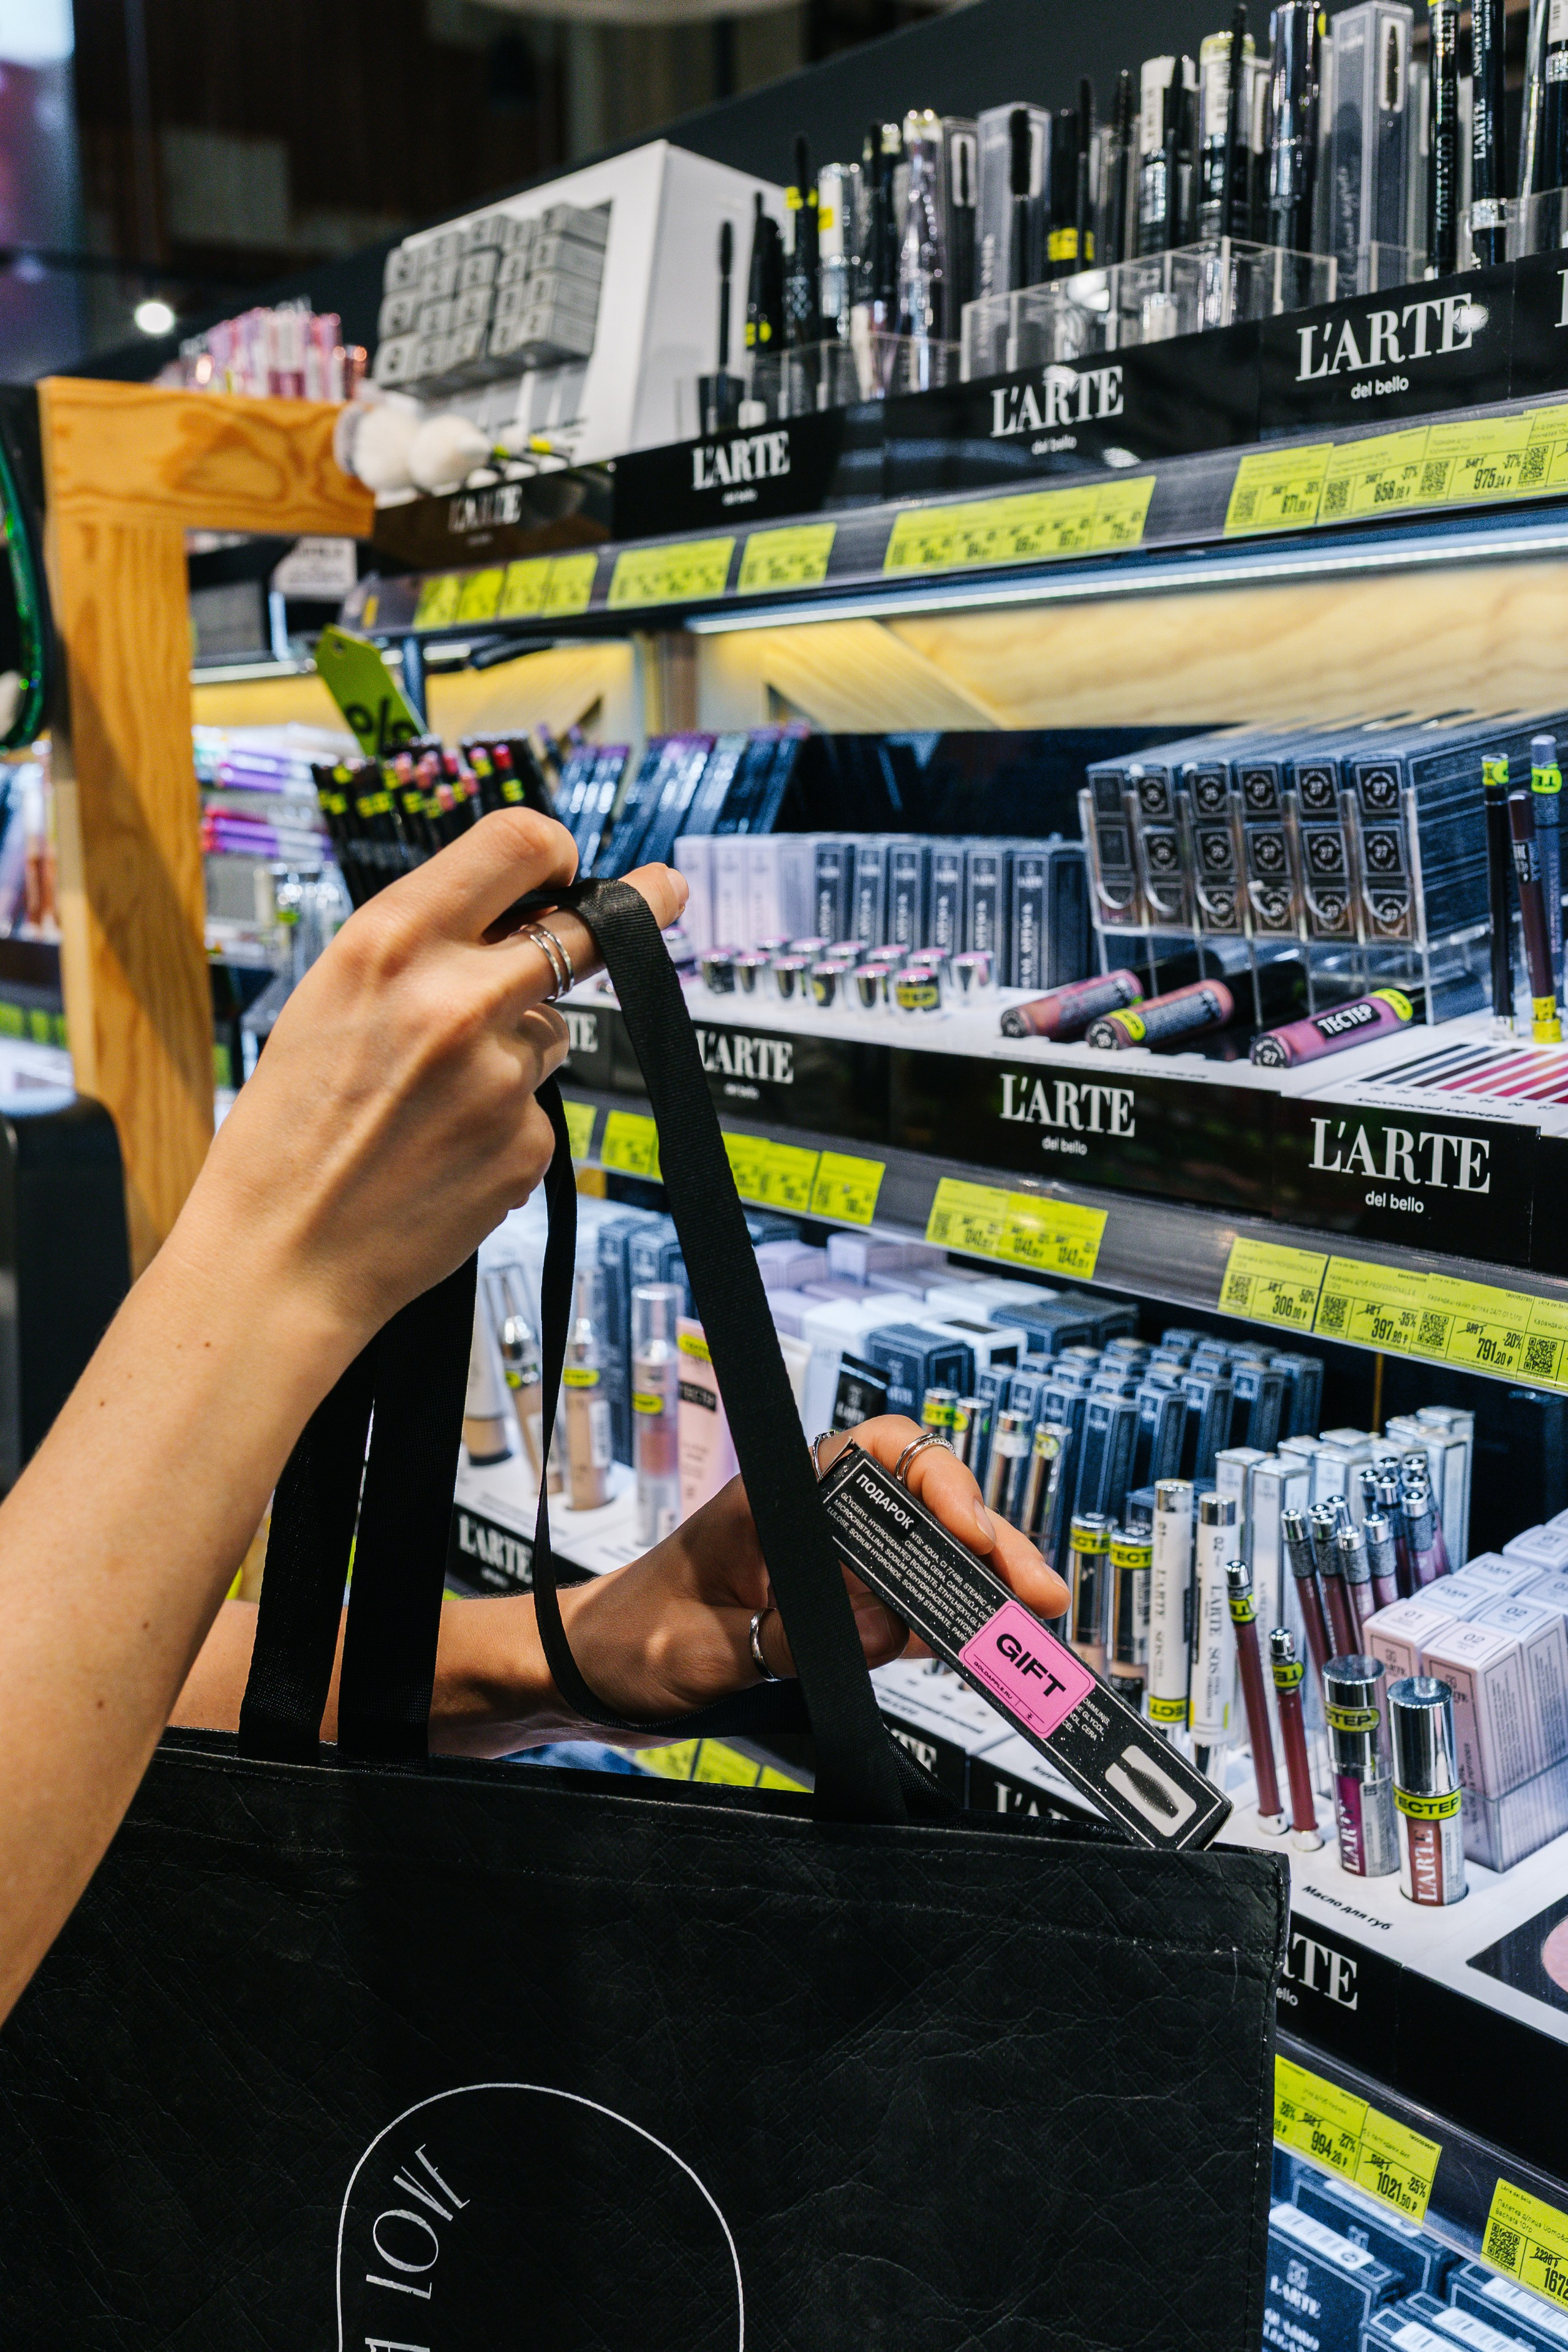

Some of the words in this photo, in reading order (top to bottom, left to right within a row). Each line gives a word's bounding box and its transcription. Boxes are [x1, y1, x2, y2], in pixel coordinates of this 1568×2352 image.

[1295, 293, 1471, 382] L'ARTE
[990, 366, 1123, 438] L'ARTE
[1351, 380, 1372, 400] del
[1375, 375, 1409, 395] bello
[691, 430, 791, 491] L'ARTE
[1309, 781, 1323, 796] 27
[1373, 782, 1388, 796] 27
[1374, 845, 1389, 859] 27
[1317, 1004, 1372, 1035] ТЕСТЕР
[695, 1029, 794, 1084] L'ARTE
[1263, 1049, 1278, 1065] 27
[1000, 1074, 1136, 1137] L'ARTE
[1042, 1136, 1058, 1150] del
[1060, 1138, 1087, 1155] bello
[1309, 1118, 1490, 1193] L'ARTE
[1365, 1190, 1386, 1207] del
[1390, 1196, 1424, 1213] bello
[1398, 1311, 1417, 1328] -35%
[1503, 1332, 1523, 1350] -20%
[855, 1473, 915, 1531] ПОДАРОК
[459, 1514, 533, 1584] L'ARTE
[1213, 1536, 1224, 1551] 02
[832, 1499, 886, 1551] MICROCRISTALLINA,
[884, 1548, 907, 1571] SODIUM
[905, 1569, 956, 1619] DEHYDROACETATE,
[955, 1616, 976, 1637] HYDRO
[840, 1492, 869, 1521] GLYCERYL
[867, 1518, 911, 1561] HYDROGENATED
[909, 1559, 939, 1588] ROSINATE,
[937, 1586, 982, 1630] ETHYLHEXYLGLY
[826, 1507, 850, 1530] LULOSE,
[848, 1528, 872, 1550] SODIUM
[869, 1548, 903, 1581] HYDROXIDE,
[901, 1578, 924, 1601] SODIUM
[922, 1599, 953, 1629] STEARATE,
[951, 1626, 969, 1645] PARFU
[903, 1539, 931, 1567] CERIFERA
[946, 1580, 979, 1613] CANDELILLA
[921, 1544, 941, 1563] AQUA,
[945, 1566, 965, 1585] 77499,
[962, 1582, 987, 1606] STEARIC
[985, 1604, 997, 1616] AC
[1210, 1584, 1223, 1636] L'ARTE
[1404, 1610, 1424, 1621] 01
[1506, 1606, 1528, 1618] 02
[1463, 1632, 1485, 1645] 02
[973, 1660, 1012, 1700] GOLDAPPLE.RU
[996, 1634, 1066, 1699] GIFT
[1081, 1710, 1107, 1735] GLYCOL,
[1082, 1697, 1111, 1725] OMMUNIS,
[1080, 1724, 1098, 1741] CERA
[1415, 1829, 1438, 1902] L'ARTE
[1302, 1885, 1343, 1907] Масло
[1340, 1905, 1367, 1920] для
[1368, 1917, 1394, 1930] губ
[1276, 1986, 1298, 2007] ello
[1339, 2133, 1356, 2153] -27%
[1408, 2176, 1428, 2198] -25%
[1495, 2207, 1518, 2225] Bachata
[1519, 2219, 1532, 2233] 10гр
[1498, 2198, 1521, 2217] Палетка
[1522, 2212, 1542, 2228] д/лица
